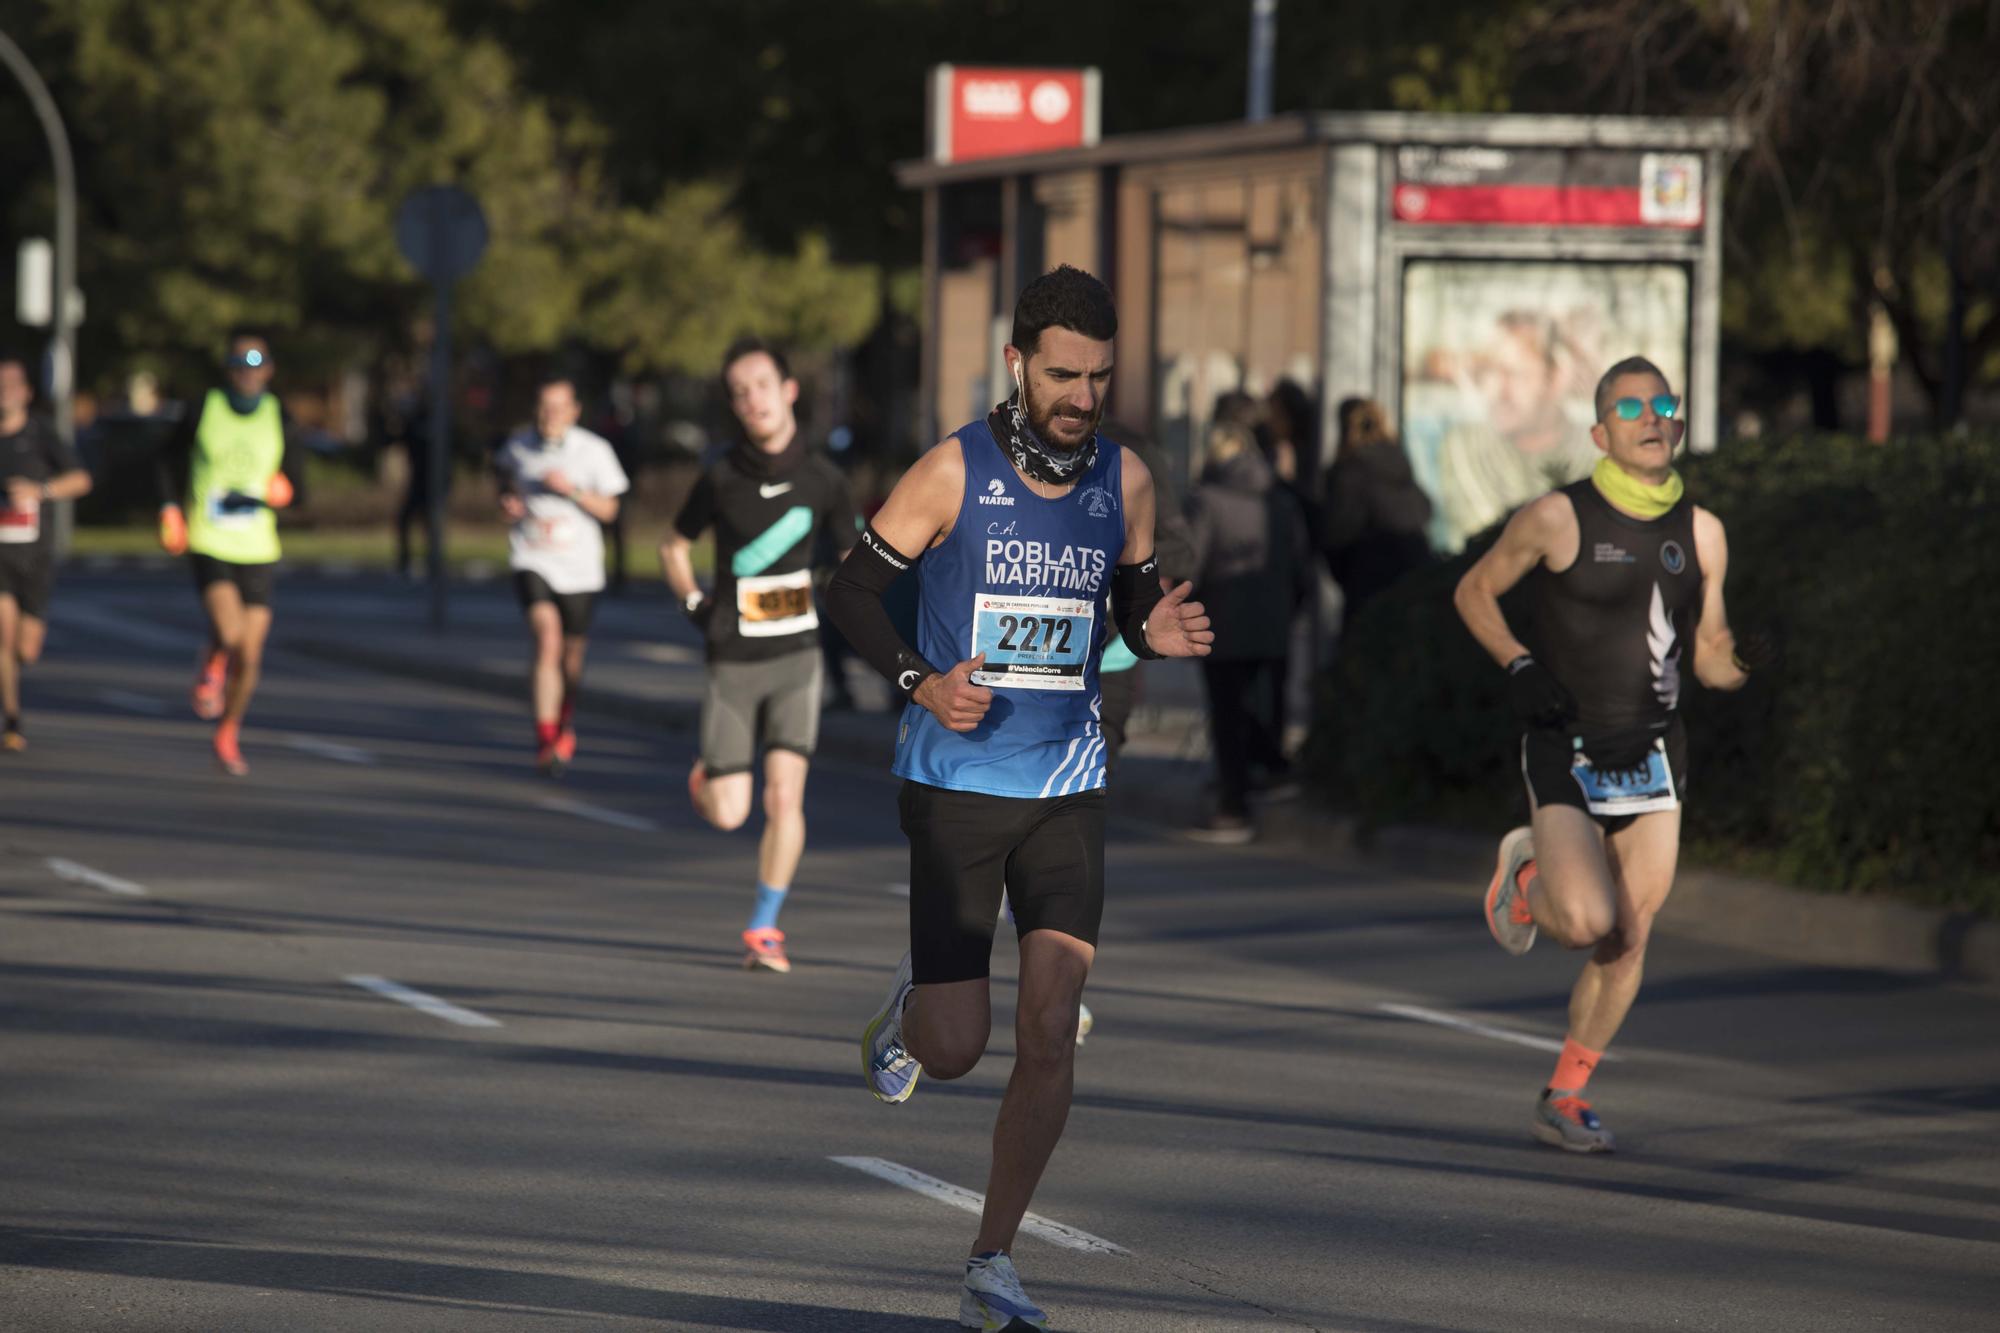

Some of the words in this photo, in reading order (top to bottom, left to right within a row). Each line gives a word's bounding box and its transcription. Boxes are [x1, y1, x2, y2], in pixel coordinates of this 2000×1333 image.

[978, 495, 1015, 506] VIATOR
[987, 521, 1018, 536] C.A.
[872, 543, 909, 570] LURBE
[986, 539, 1106, 572] POBLATS
[985, 562, 1103, 592] MARITIMS
[997, 615, 1072, 653] 2272
[1008, 664, 1062, 674] #ValènciaCorre
